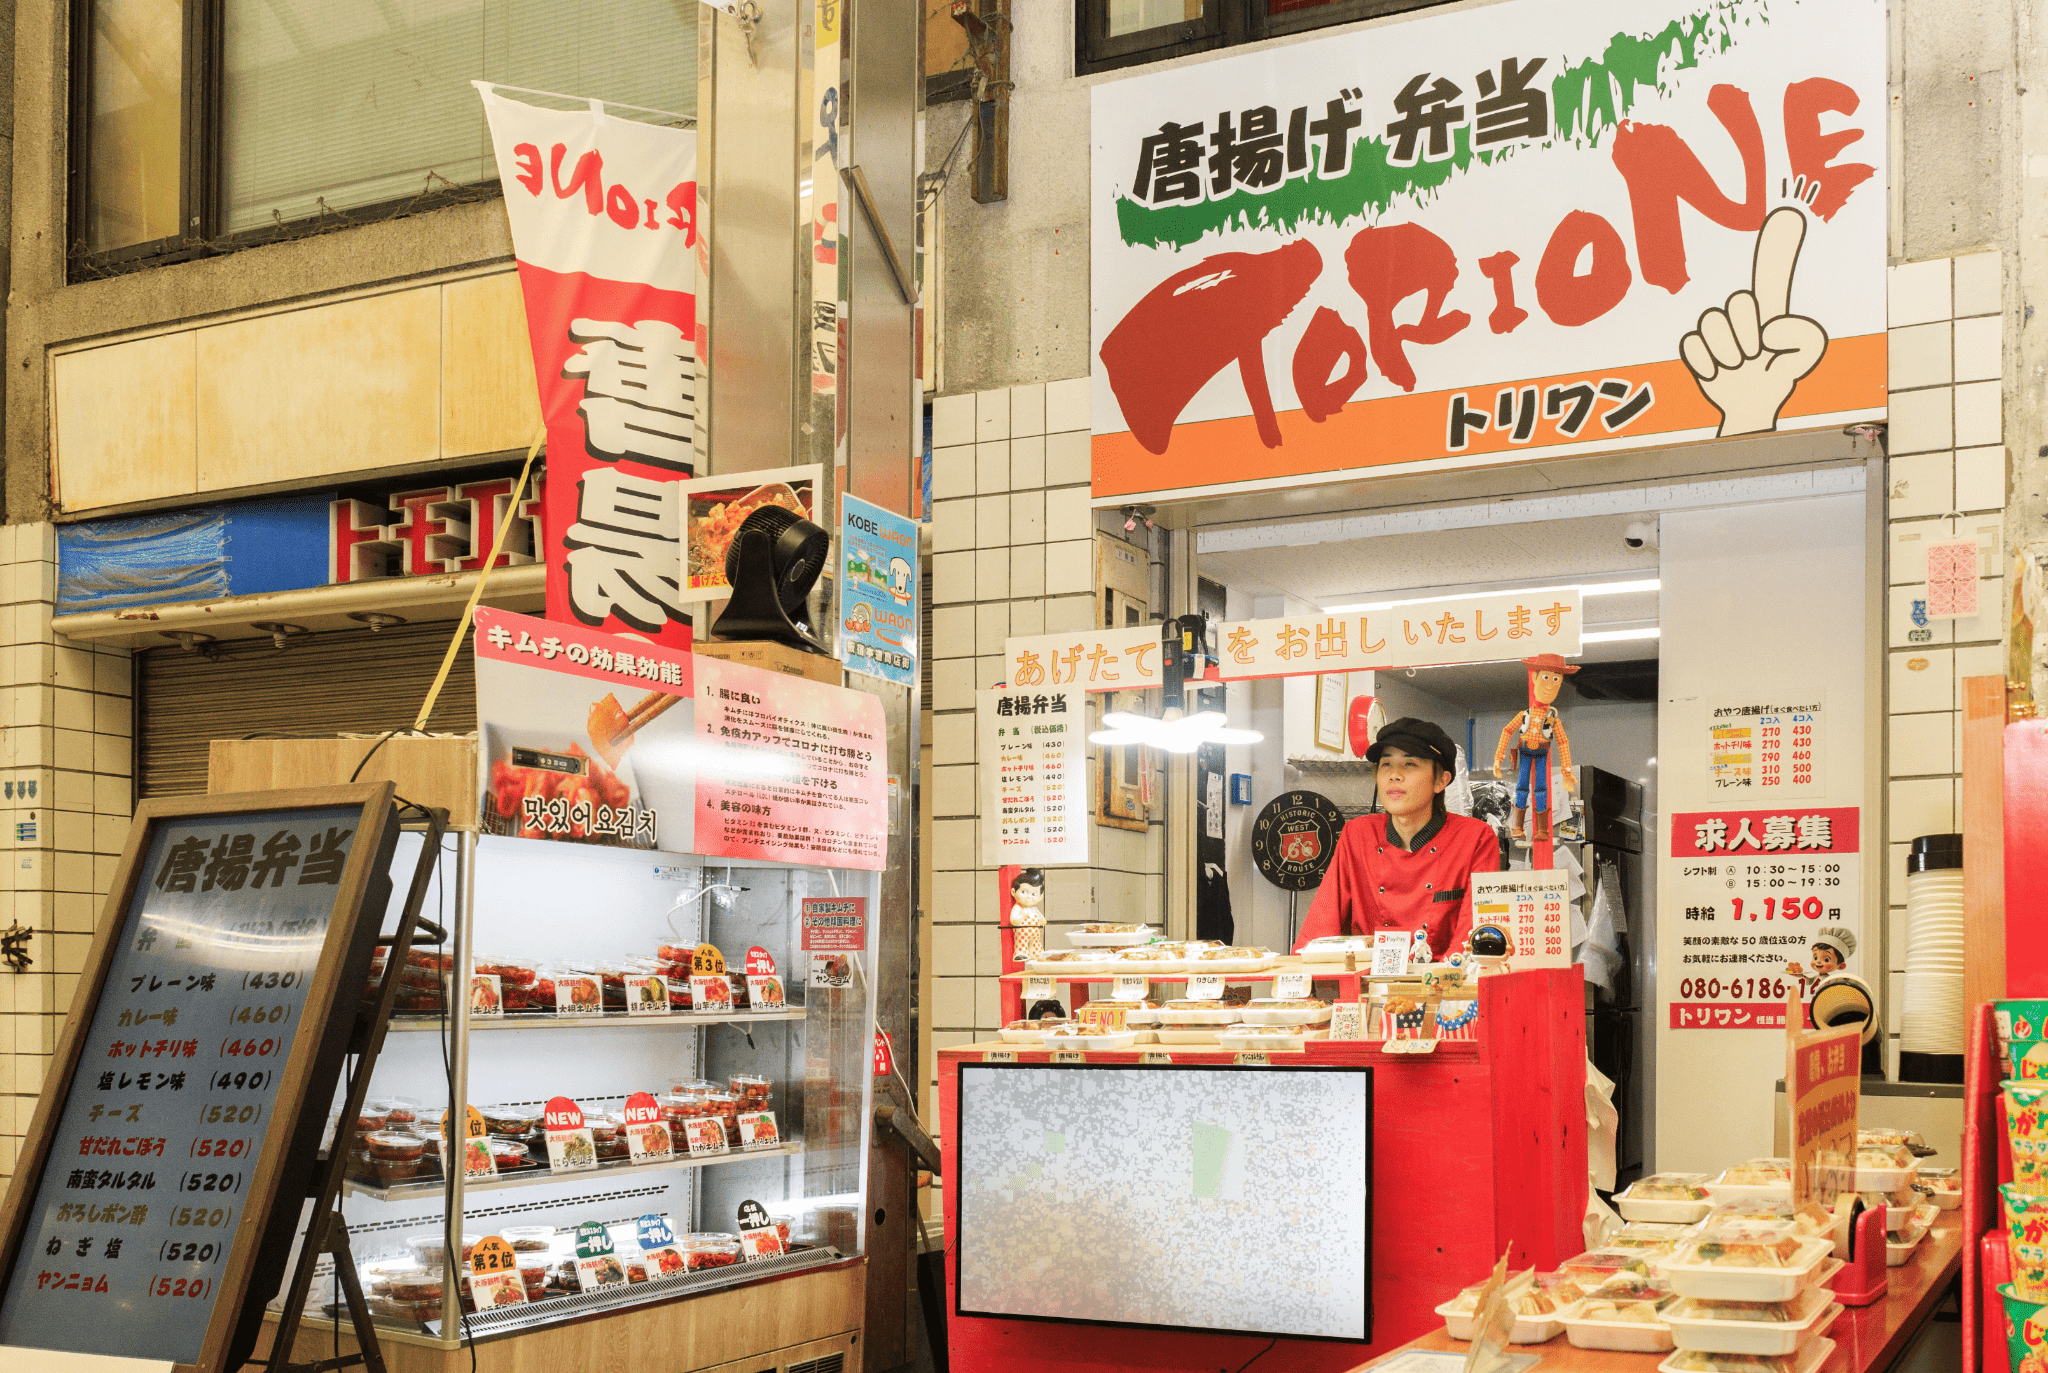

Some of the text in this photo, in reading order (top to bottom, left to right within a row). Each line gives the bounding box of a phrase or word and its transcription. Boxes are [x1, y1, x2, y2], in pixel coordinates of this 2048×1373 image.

[1132, 57, 1548, 204] 唐揚げ 弁当
[1099, 76, 1878, 456] TORIONE
[1450, 381, 1651, 448] トリワン
[848, 513, 878, 536] KOBE
[879, 525, 914, 550] WAON
[874, 607, 913, 633] WAON
[1015, 642, 1157, 687] あげたて
[1403, 600, 1572, 646] いたします
[487, 624, 683, 686] キムチの効果効能
[997, 693, 1067, 716] 唐揚弁当
[1762, 727, 1780, 737] 270
[1793, 725, 1812, 735] 430
[1714, 738, 1812, 751] ホットチリ味 270 430
[1762, 751, 1811, 762] 290 460
[1714, 763, 1812, 777] チーズ味 310 500
[1715, 775, 1812, 788] プレーン味 250 400
[1292, 794, 1303, 805] 12
[720, 800, 772, 817] 美容の味方
[1273, 803, 1281, 814] 11
[1280, 810, 1316, 822] HISTORIC
[1329, 811, 1337, 822] 2
[1260, 819, 1270, 830] 10
[1288, 824, 1309, 832] WEST
[1695, 815, 1832, 852] 求人募集
[1256, 840, 1264, 850] 9
[1288, 840, 1313, 859] 66
[155, 827, 354, 893] 唐揚弁当
[1263, 860, 1271, 870] 8
[1288, 862, 1315, 872] ROUTE
[1683, 866, 1717, 876] シフト制
[1278, 873, 1285, 884] 7
[1298, 876, 1306, 887] 6
[1518, 903, 1560, 913] 270 430
[1686, 896, 1841, 922] 時給 1,150 円
[1478, 913, 1561, 924] ホットチリ味 270 430
[1519, 925, 1561, 935] 290 460
[1519, 936, 1562, 946] 310 500
[1742, 937, 1756, 945] 50
[1520, 946, 1562, 956] 250 400
[130, 970, 304, 993] プレーン味 (430)
[816, 975, 850, 984] ヤンニョム
[117, 1004, 292, 1027] カレー味 (460)
[559, 1004, 601, 1013] 大根キムチ
[1679, 1007, 1774, 1026] トリワン 担当
[107, 1037, 282, 1058] ホットチリ味 (460)
[97, 1070, 272, 1091] 塩レモン味 (490)
[88, 1104, 262, 1126] チーズ (520)
[546, 1112, 581, 1126] NEW
[626, 1107, 658, 1122] NEW
[78, 1136, 252, 1160] 甘だれごぼう (520)
[66, 1168, 242, 1194] 南蛮タルタル (520)
[56, 1202, 232, 1228] おろしポン酢 (520)
[160, 1239, 222, 1264] (520)
[483, 1242, 500, 1251] 人気
[473, 1252, 514, 1271] 第2位
[38, 1269, 212, 1300] ヤンニョム (520)
